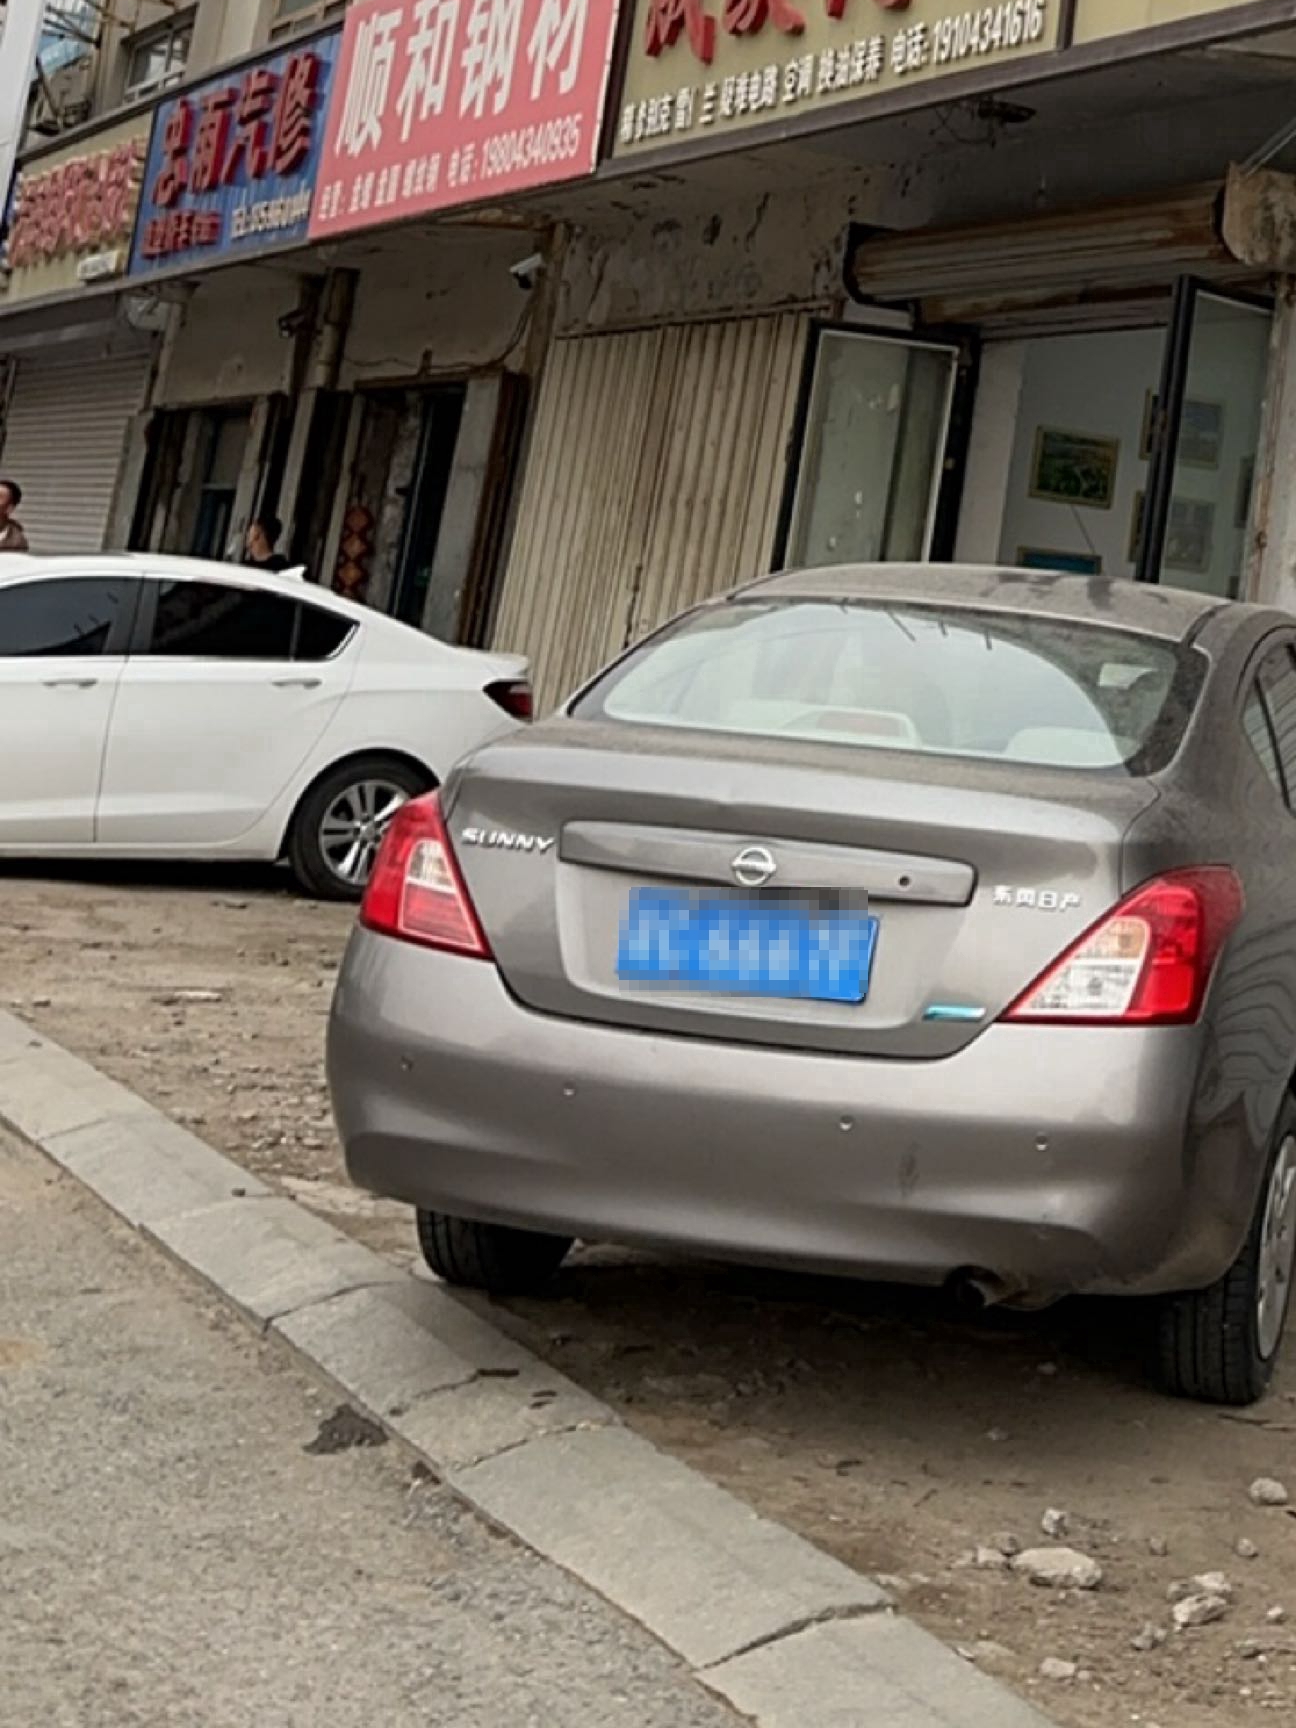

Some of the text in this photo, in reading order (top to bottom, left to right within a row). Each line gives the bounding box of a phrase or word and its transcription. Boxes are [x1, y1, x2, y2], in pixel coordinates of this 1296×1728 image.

[461, 827, 555, 854] SUNNY
[992, 884, 1081, 912] 东风日产
